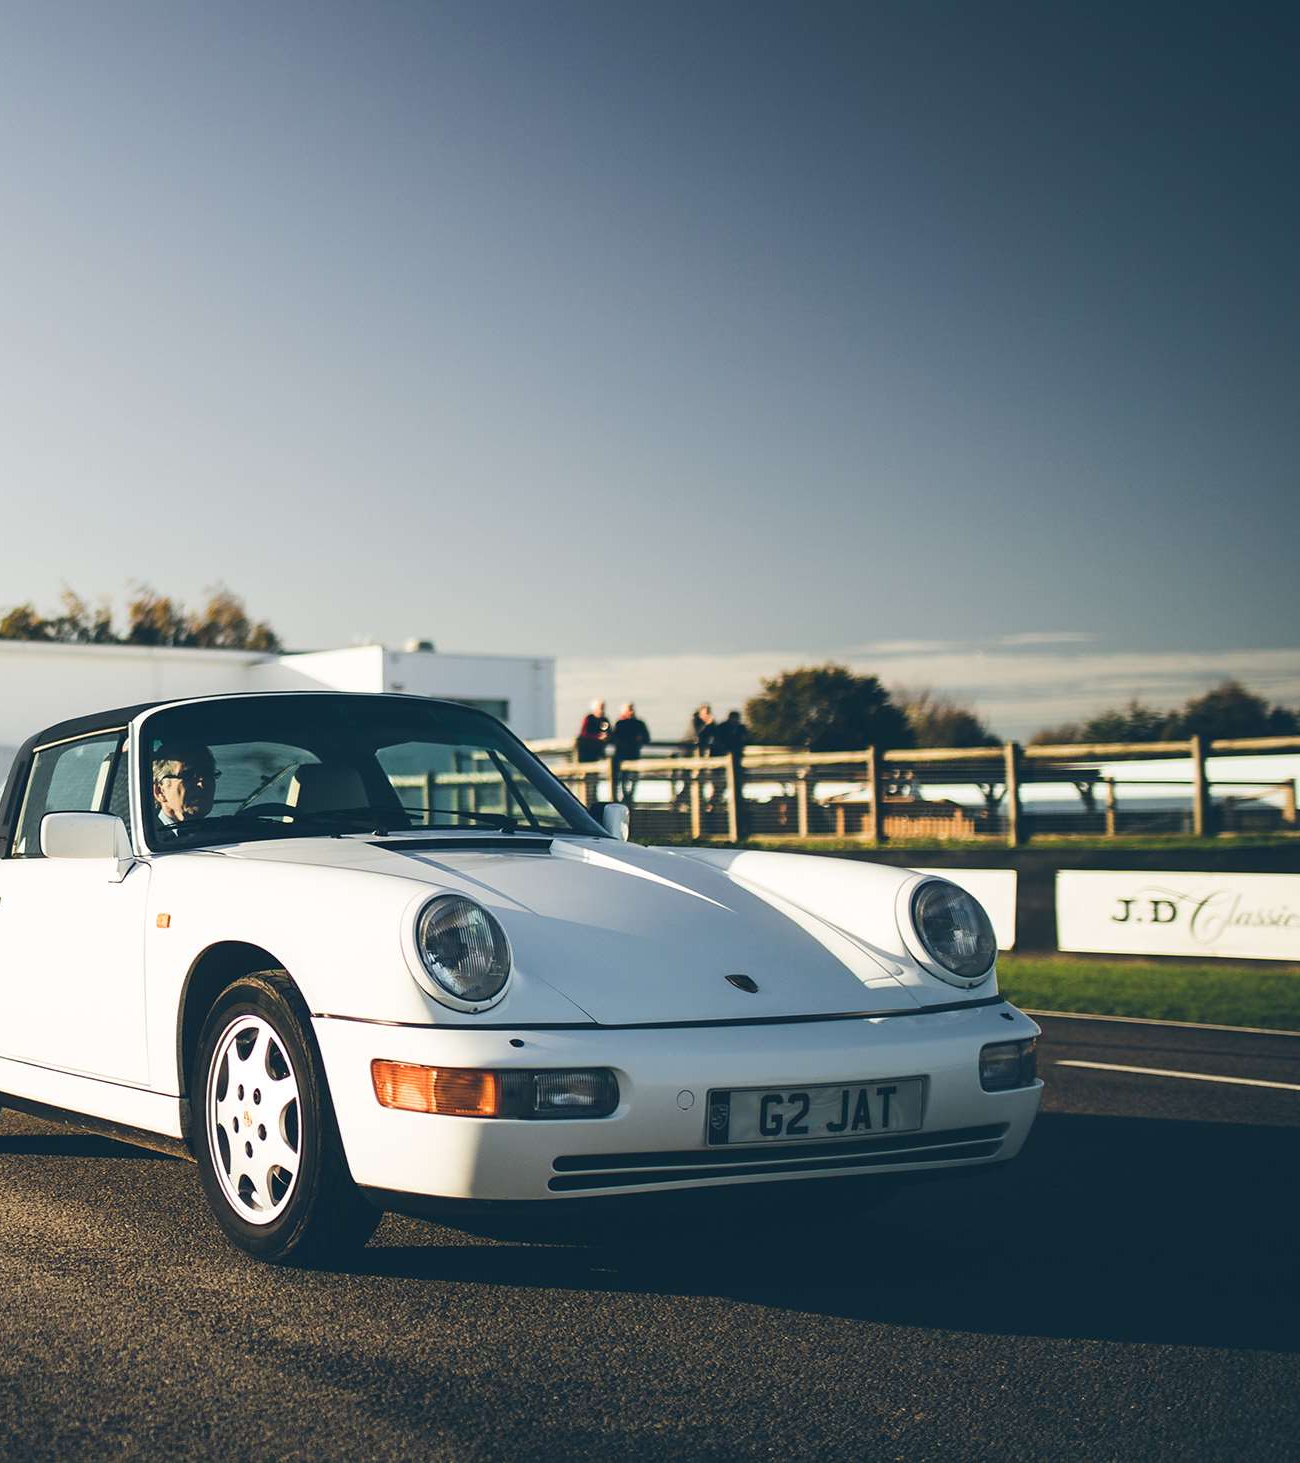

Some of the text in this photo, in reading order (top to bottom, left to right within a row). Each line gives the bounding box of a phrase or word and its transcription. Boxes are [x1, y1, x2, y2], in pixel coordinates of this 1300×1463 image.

[1111, 899, 1177, 923] J.D
[759, 1085, 897, 1137] G2 JAT
